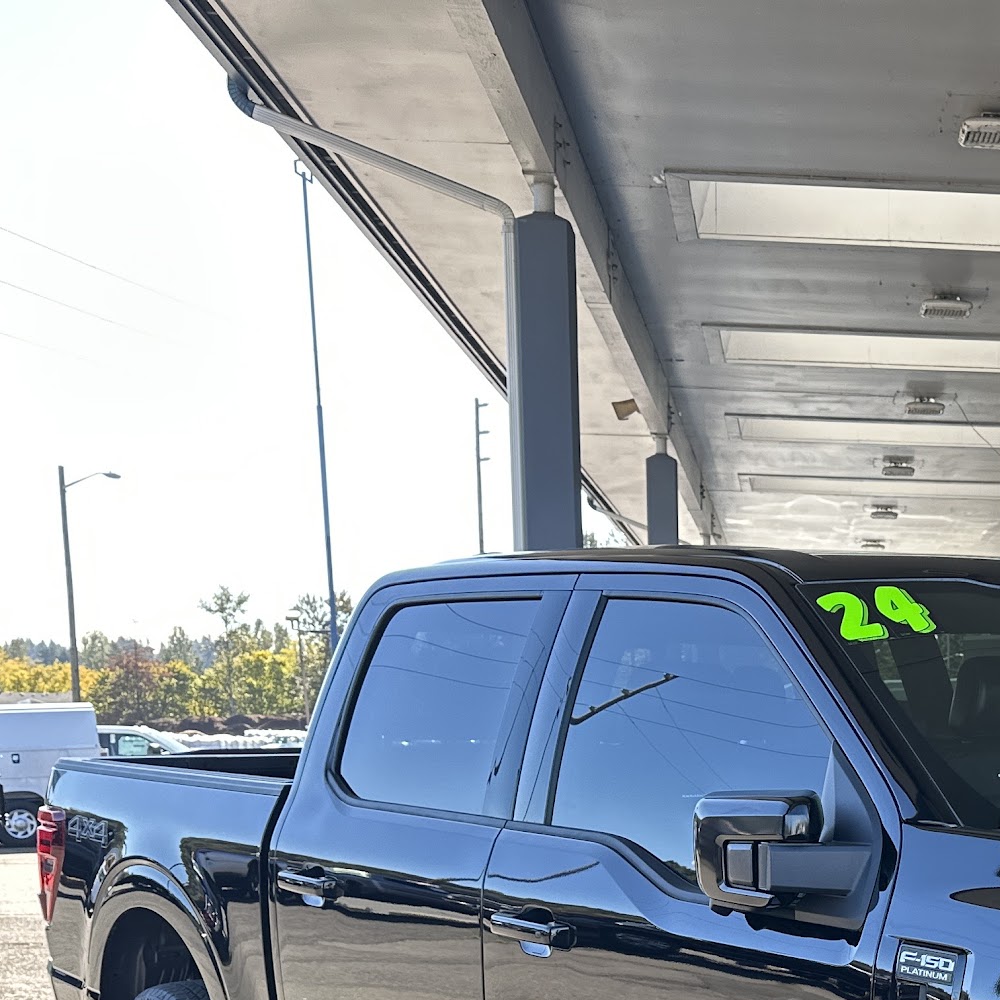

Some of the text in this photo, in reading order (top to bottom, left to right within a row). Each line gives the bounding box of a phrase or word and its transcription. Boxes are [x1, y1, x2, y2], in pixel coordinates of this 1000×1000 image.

[816, 585, 937, 642] 24
[900, 951, 955, 972] F-150
[901, 965, 948, 981] PLATINUM
